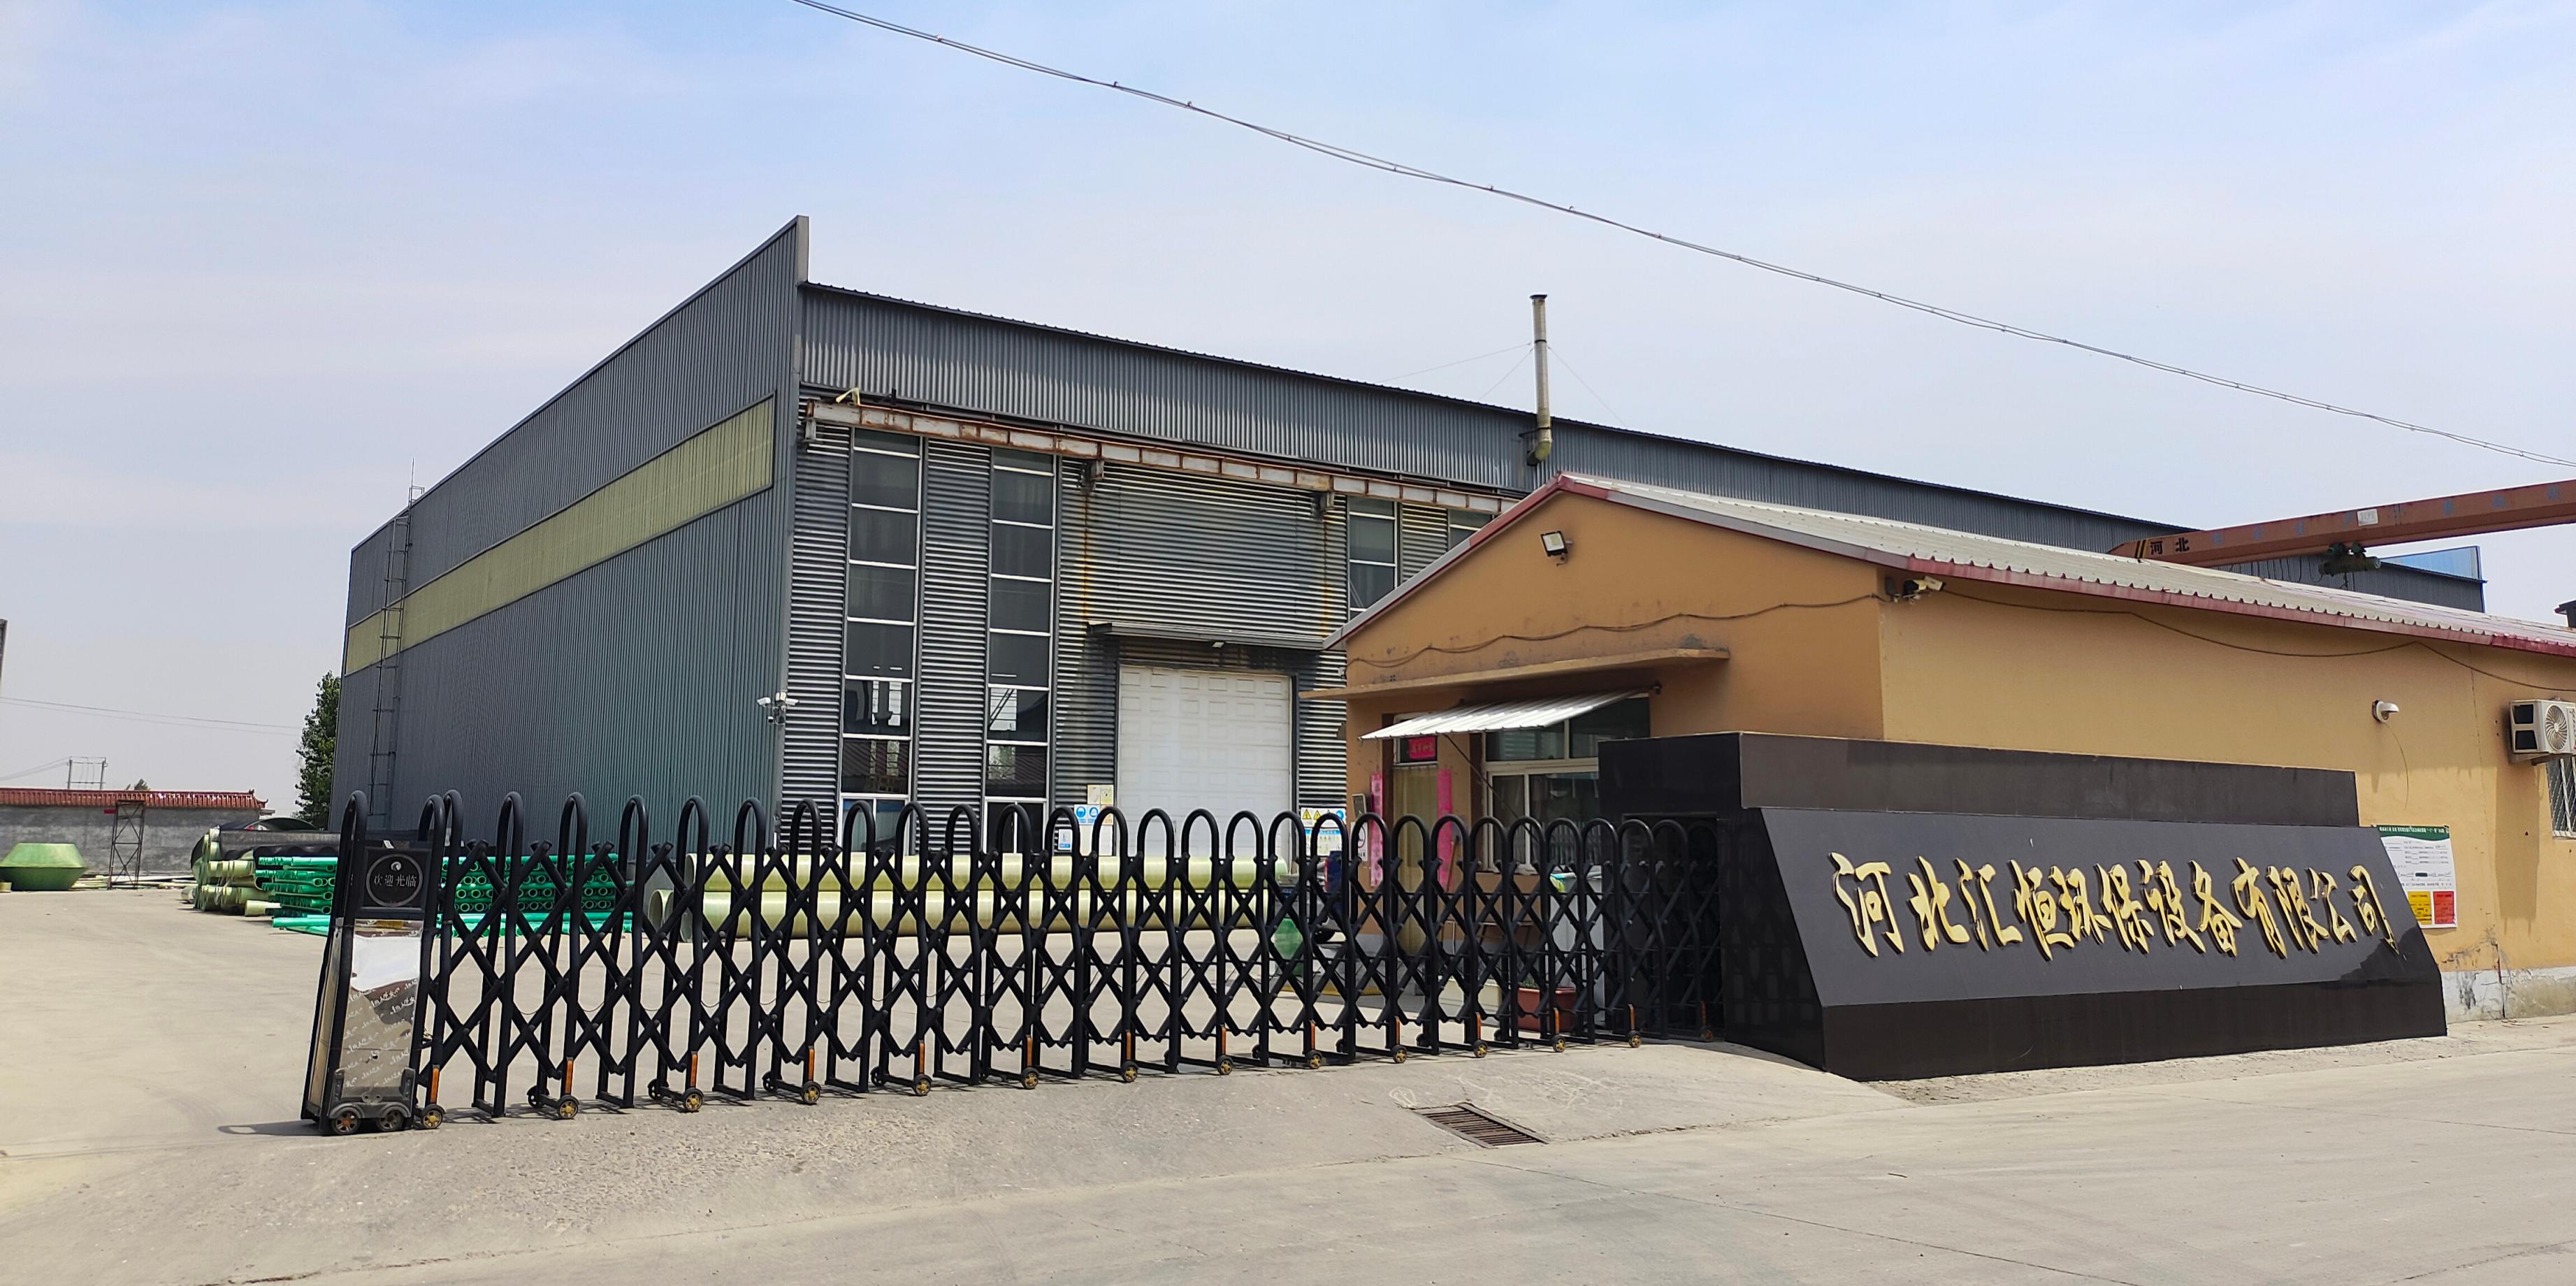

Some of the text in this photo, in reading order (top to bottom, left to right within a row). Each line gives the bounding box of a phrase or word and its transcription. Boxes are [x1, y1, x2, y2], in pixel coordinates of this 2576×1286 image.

[373, 873, 417, 888] 欢迎光临
[1830, 852, 2400, 961] 河北汇恒环保设备有限公司
